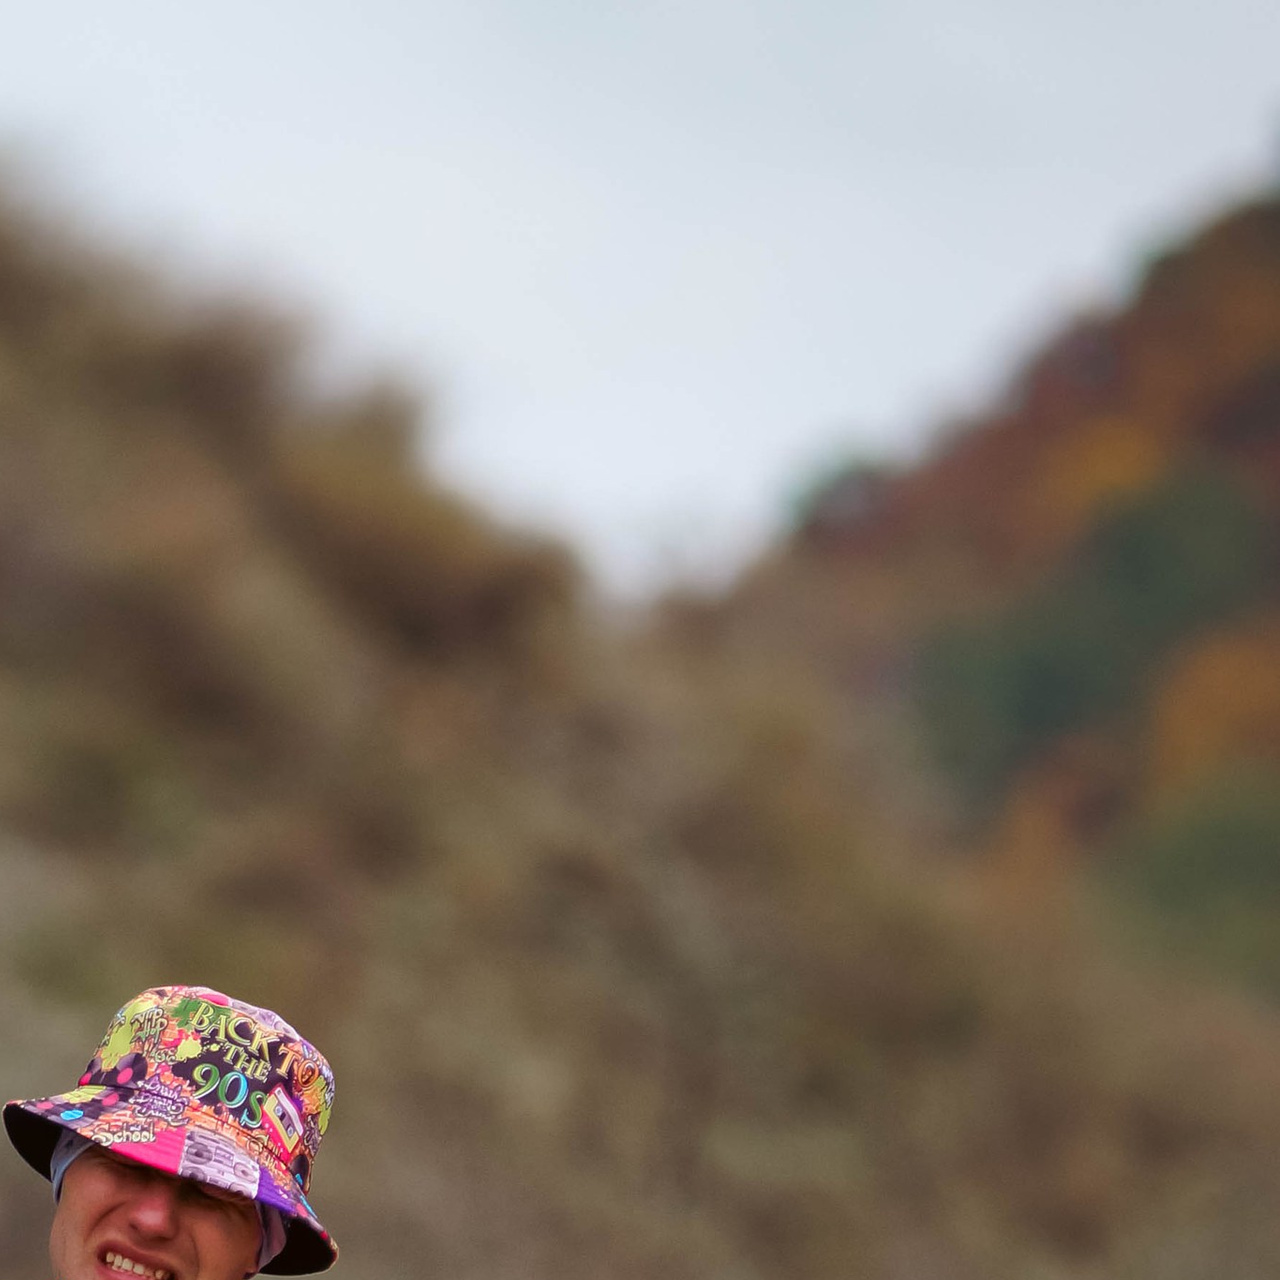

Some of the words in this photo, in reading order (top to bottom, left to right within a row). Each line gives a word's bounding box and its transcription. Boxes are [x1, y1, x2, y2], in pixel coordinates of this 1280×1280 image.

[190, 1001, 280, 1063] BACK
[276, 1043, 320, 1089] TO
[223, 1041, 272, 1083] THE
[91, 1121, 157, 1147] School
